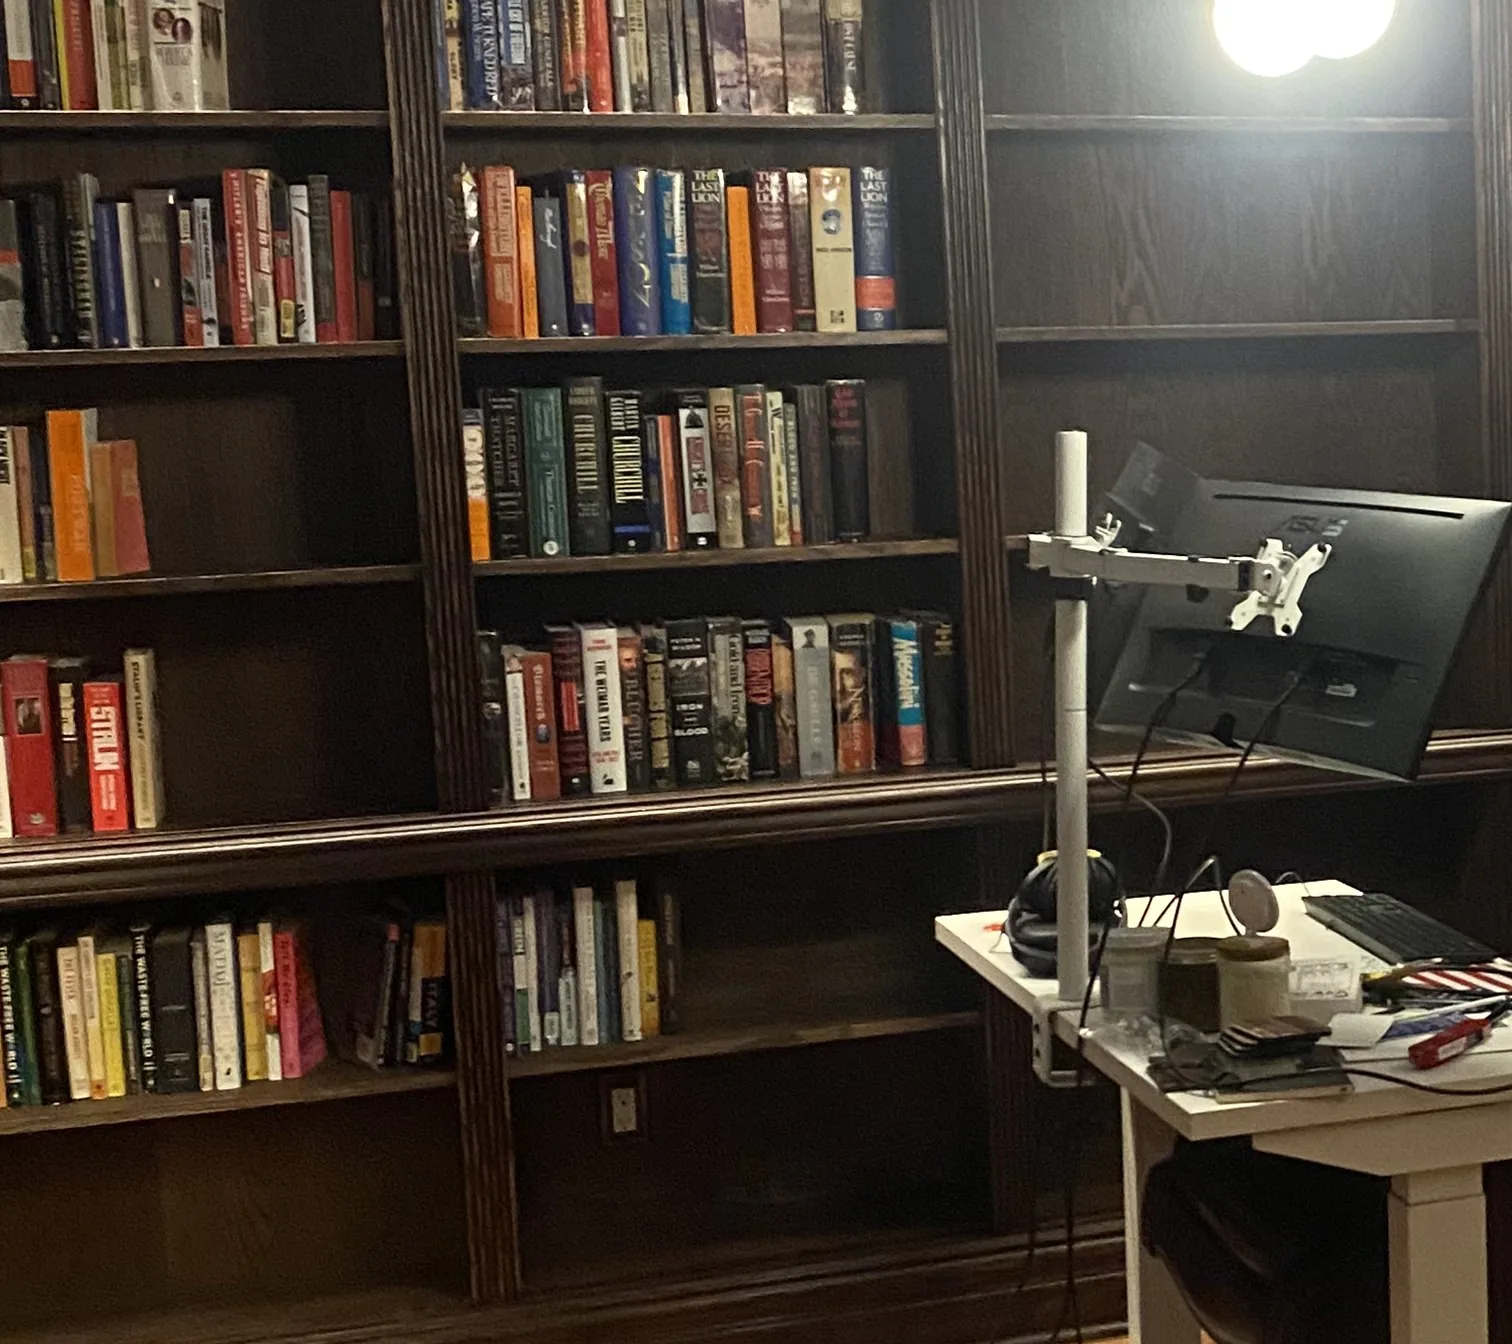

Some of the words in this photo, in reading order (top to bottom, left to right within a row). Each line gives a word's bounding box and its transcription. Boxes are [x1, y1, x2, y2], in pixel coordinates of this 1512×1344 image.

[612, 436, 644, 503] CHURCHILL
[90, 707, 120, 771] STALIN
[134, 935, 146, 954] THE
